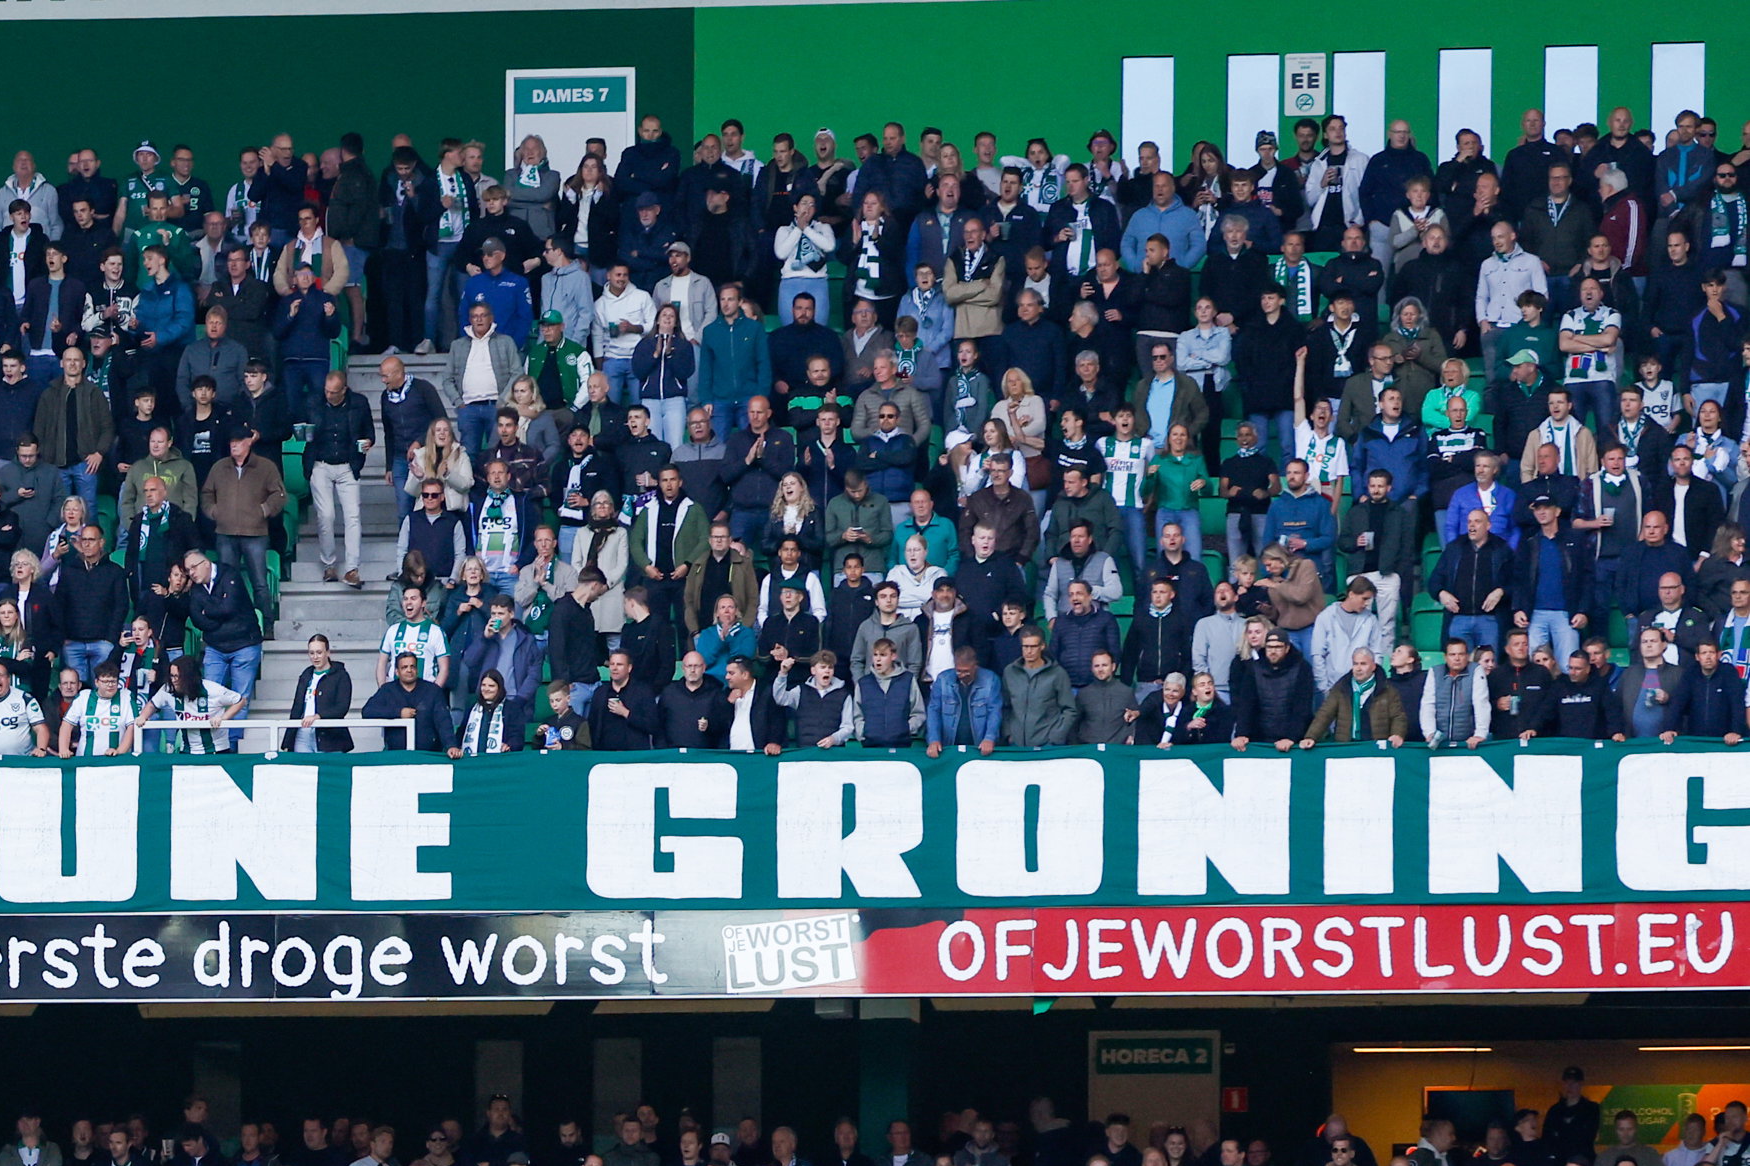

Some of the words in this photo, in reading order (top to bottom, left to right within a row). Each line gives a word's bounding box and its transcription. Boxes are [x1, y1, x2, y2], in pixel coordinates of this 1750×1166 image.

[532, 87, 594, 103] DAMES
[598, 87, 609, 102] 7
[1291, 72, 1320, 90] EE
[587, 752, 1750, 899] GRONING
[724, 927, 743, 939] OF
[746, 917, 847, 949] WORST
[728, 939, 747, 952] JE
[938, 912, 1733, 981] OFJEWORSTLUST.EU
[193, 920, 413, 1000] droge
[440, 918, 668, 987] worst
[728, 942, 849, 989] LUST
[1100, 1048, 1188, 1065] HORECA
[1193, 1048, 1208, 1064] 2
